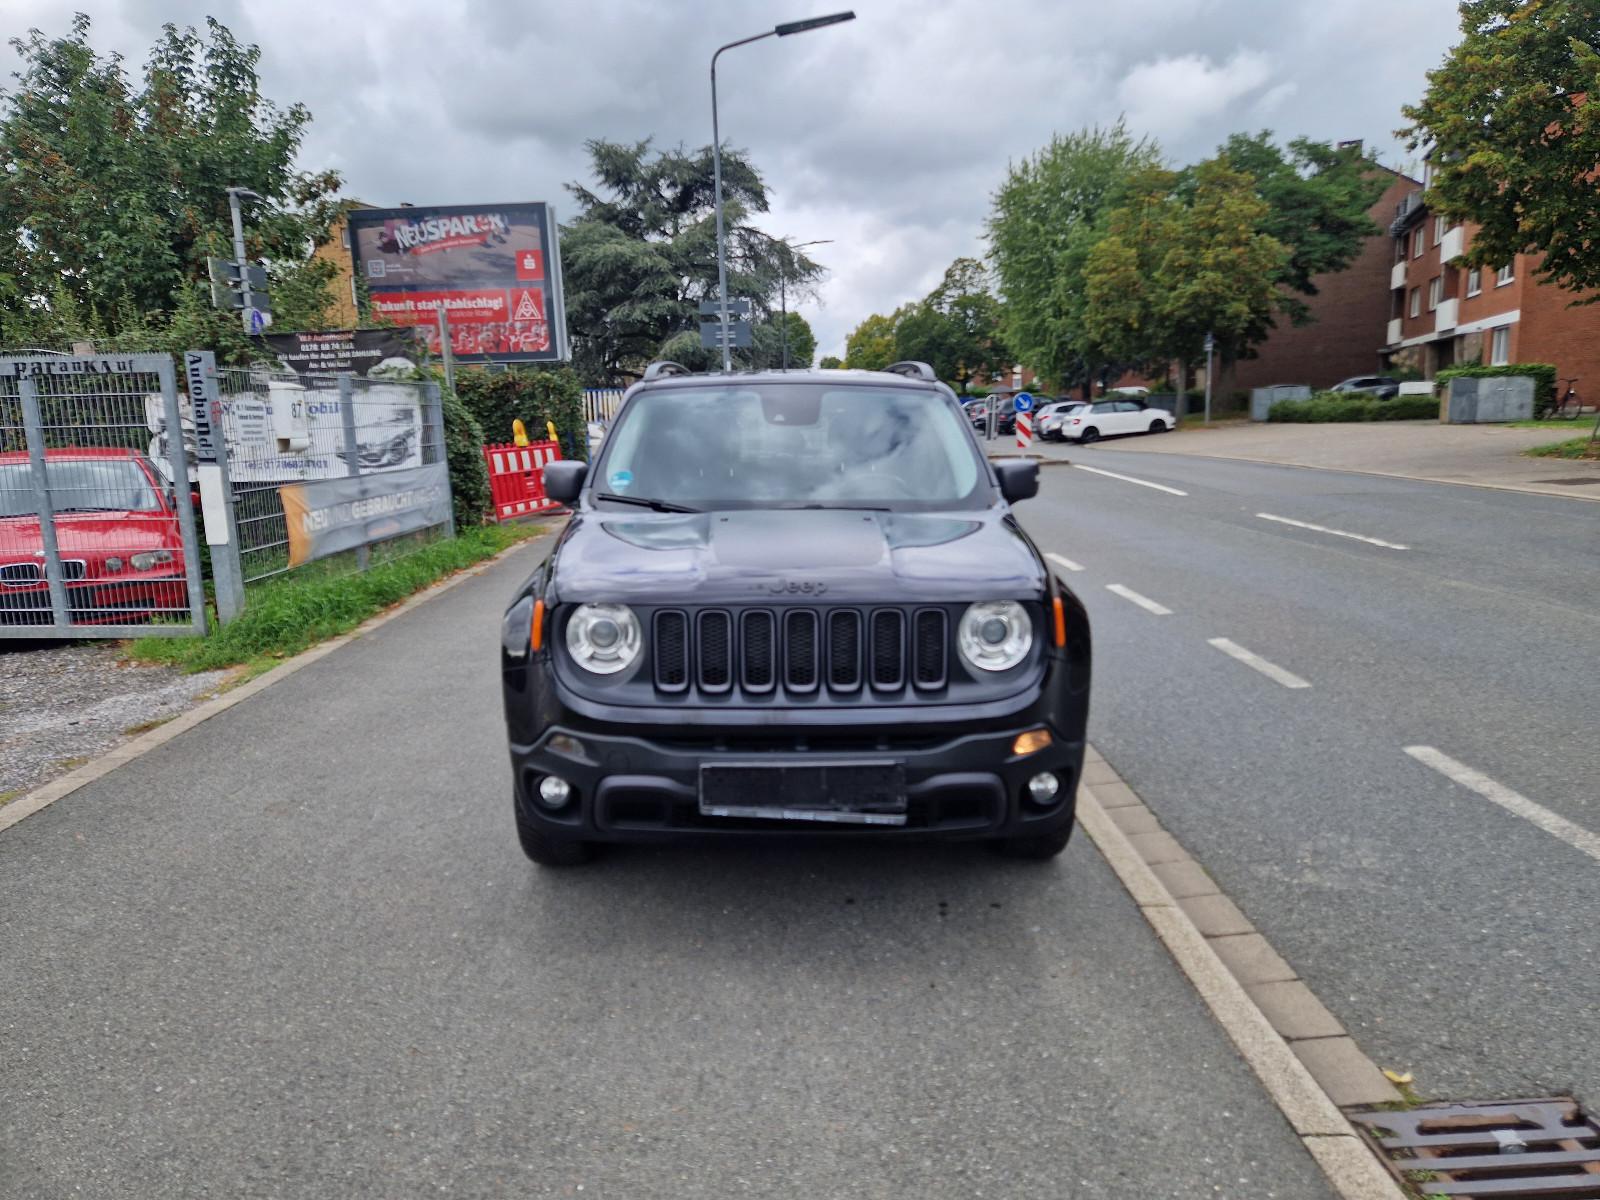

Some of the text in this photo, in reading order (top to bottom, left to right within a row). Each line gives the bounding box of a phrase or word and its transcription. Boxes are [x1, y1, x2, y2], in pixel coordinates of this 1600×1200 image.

[443, 296, 503, 310] Kahlschlag!
[291, 400, 302, 418] 87
[768, 578, 829, 598] Jeep
